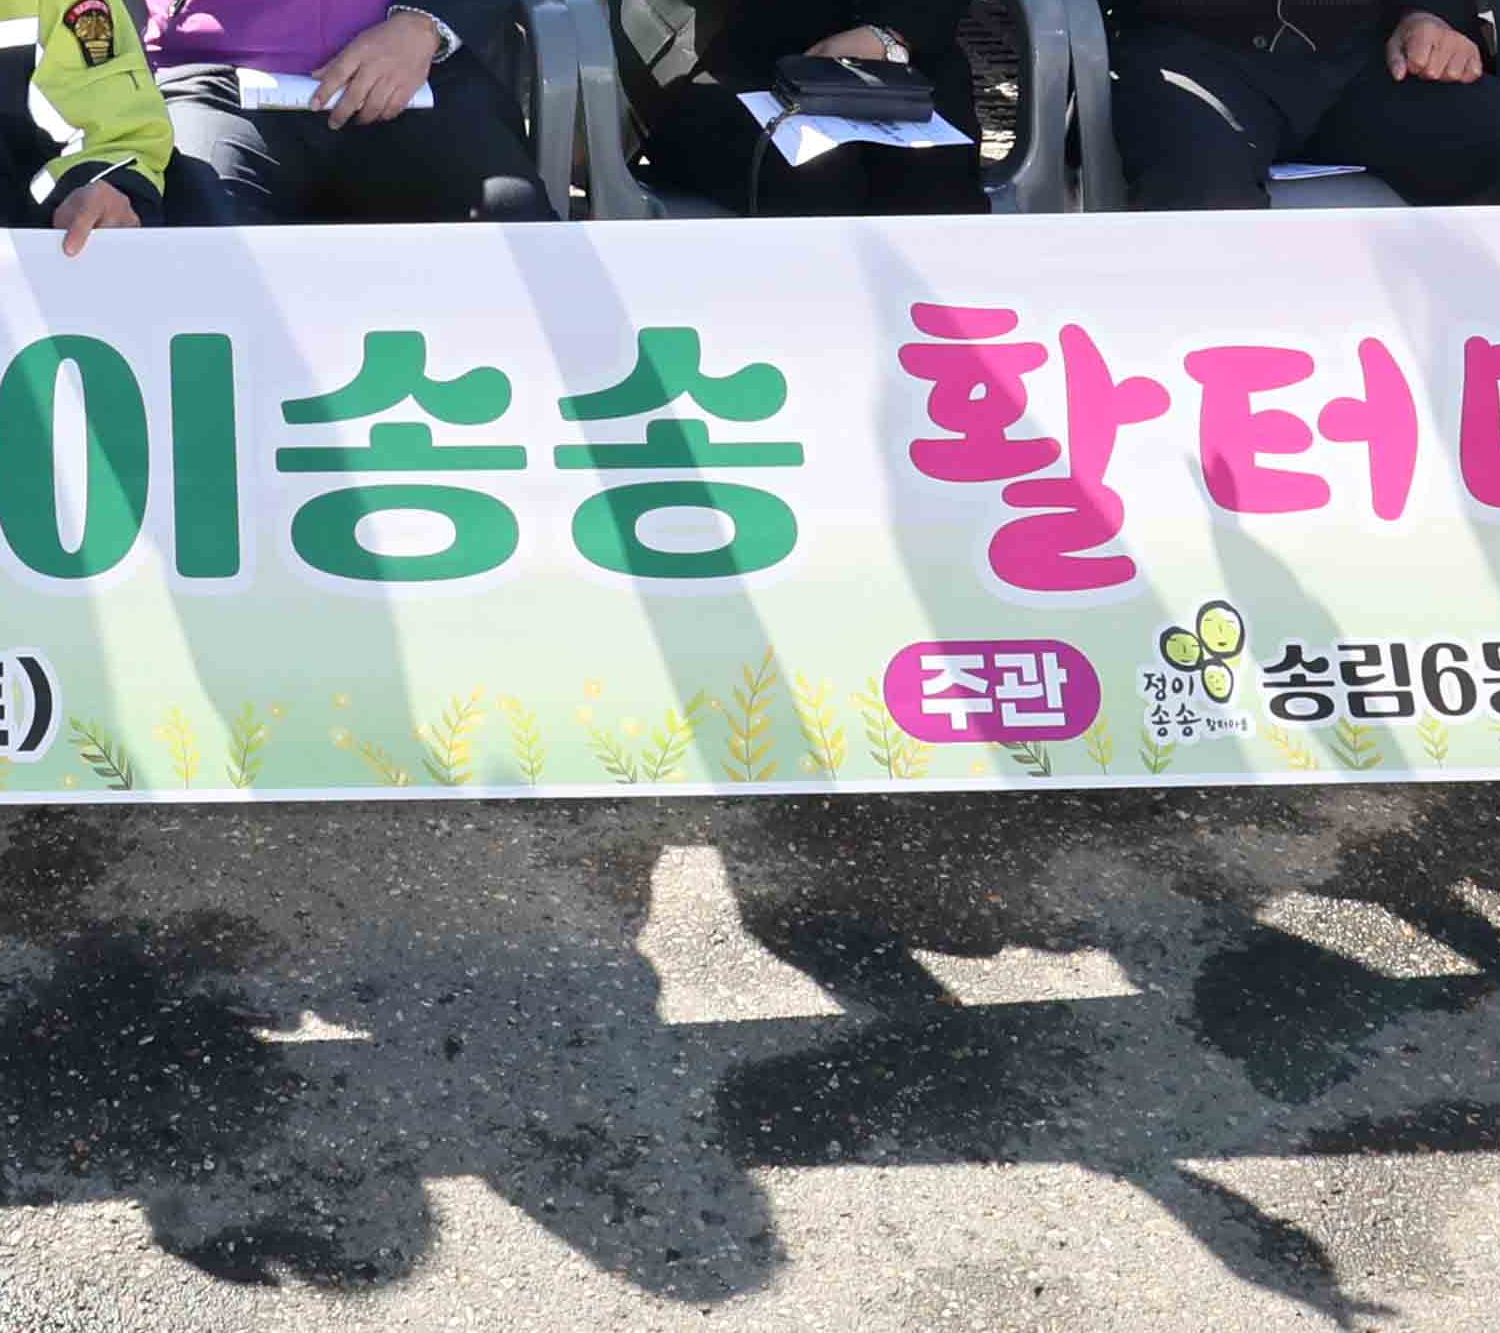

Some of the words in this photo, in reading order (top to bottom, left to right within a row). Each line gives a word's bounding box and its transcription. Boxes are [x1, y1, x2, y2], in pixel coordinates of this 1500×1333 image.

[920, 651, 1067, 731] 주관
[1143, 672, 1194, 702] 정이
[1150, 702, 1202, 737] 송송
